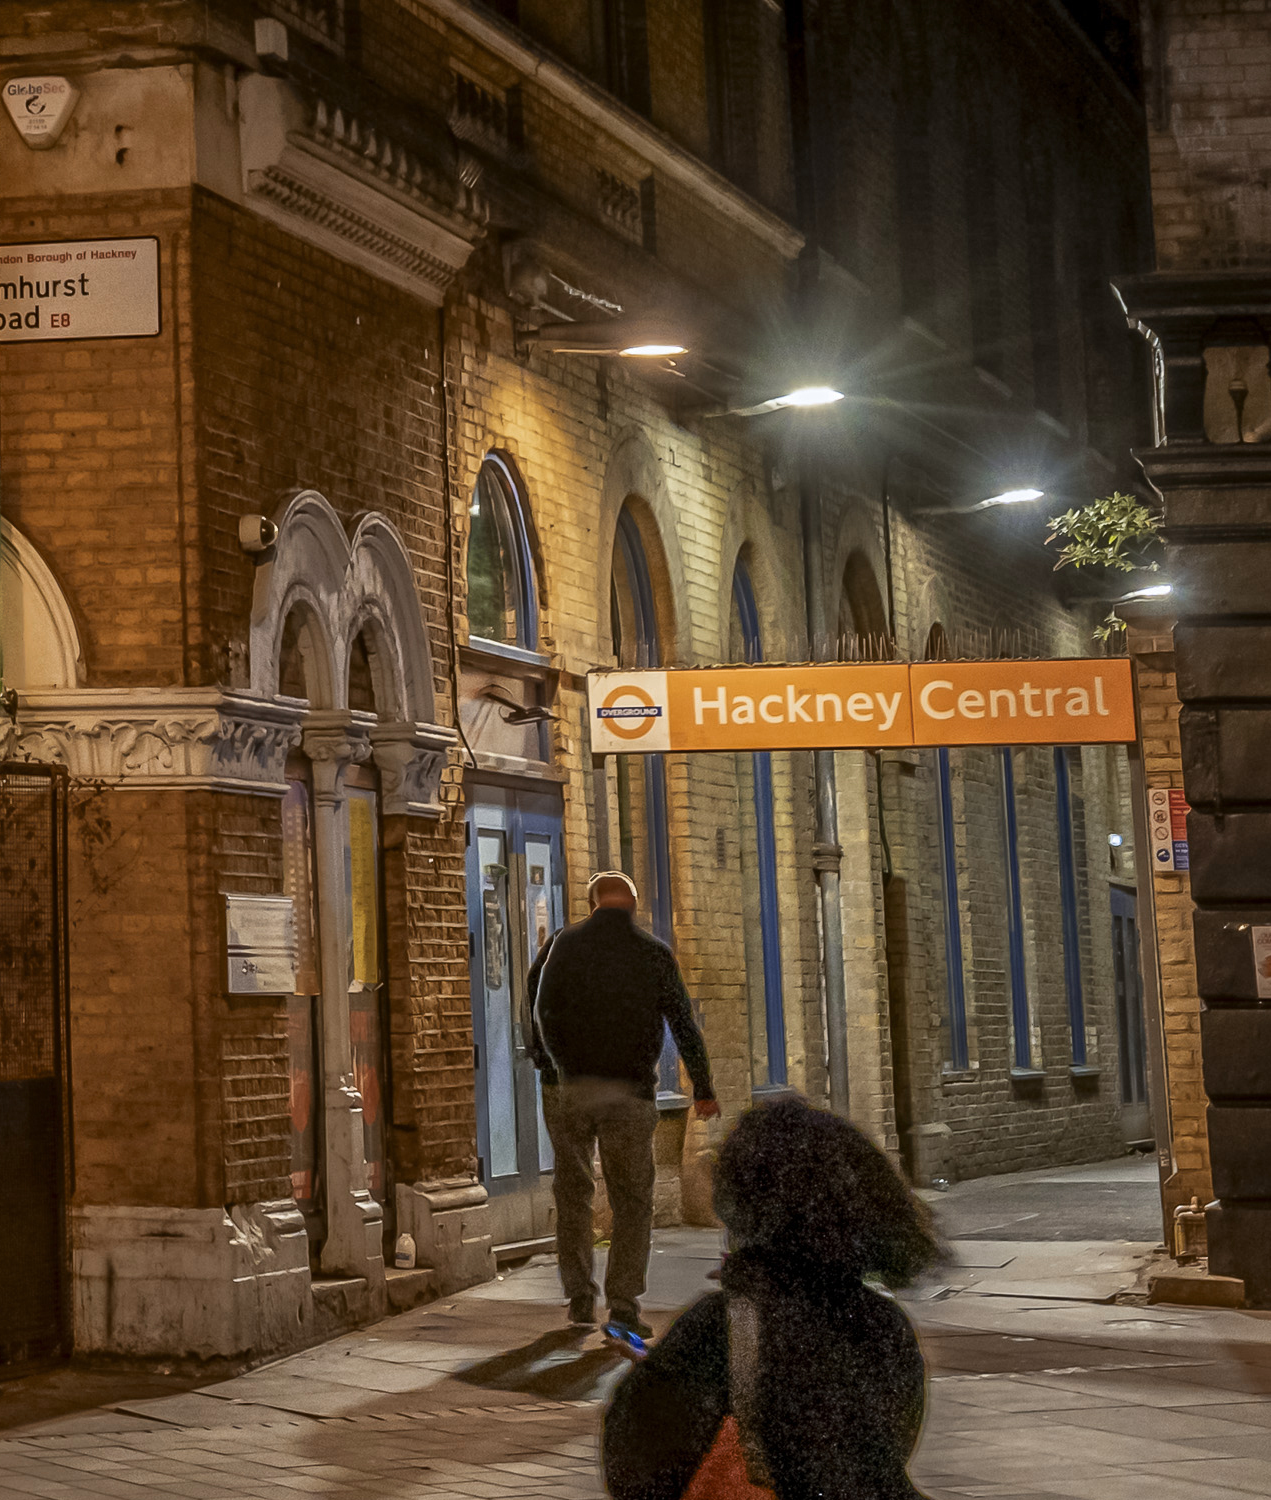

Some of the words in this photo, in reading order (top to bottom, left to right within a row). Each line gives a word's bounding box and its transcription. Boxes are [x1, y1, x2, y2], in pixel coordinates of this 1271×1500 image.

[27, 251, 72, 264] Borough
[76, 251, 86, 260] of
[91, 249, 137, 260] Hackney
[50, 313, 70, 328] E8
[693, 685, 902, 731] Hackney
[920, 676, 1110, 720] Central
[601, 708, 658, 717] OVERGROUND
